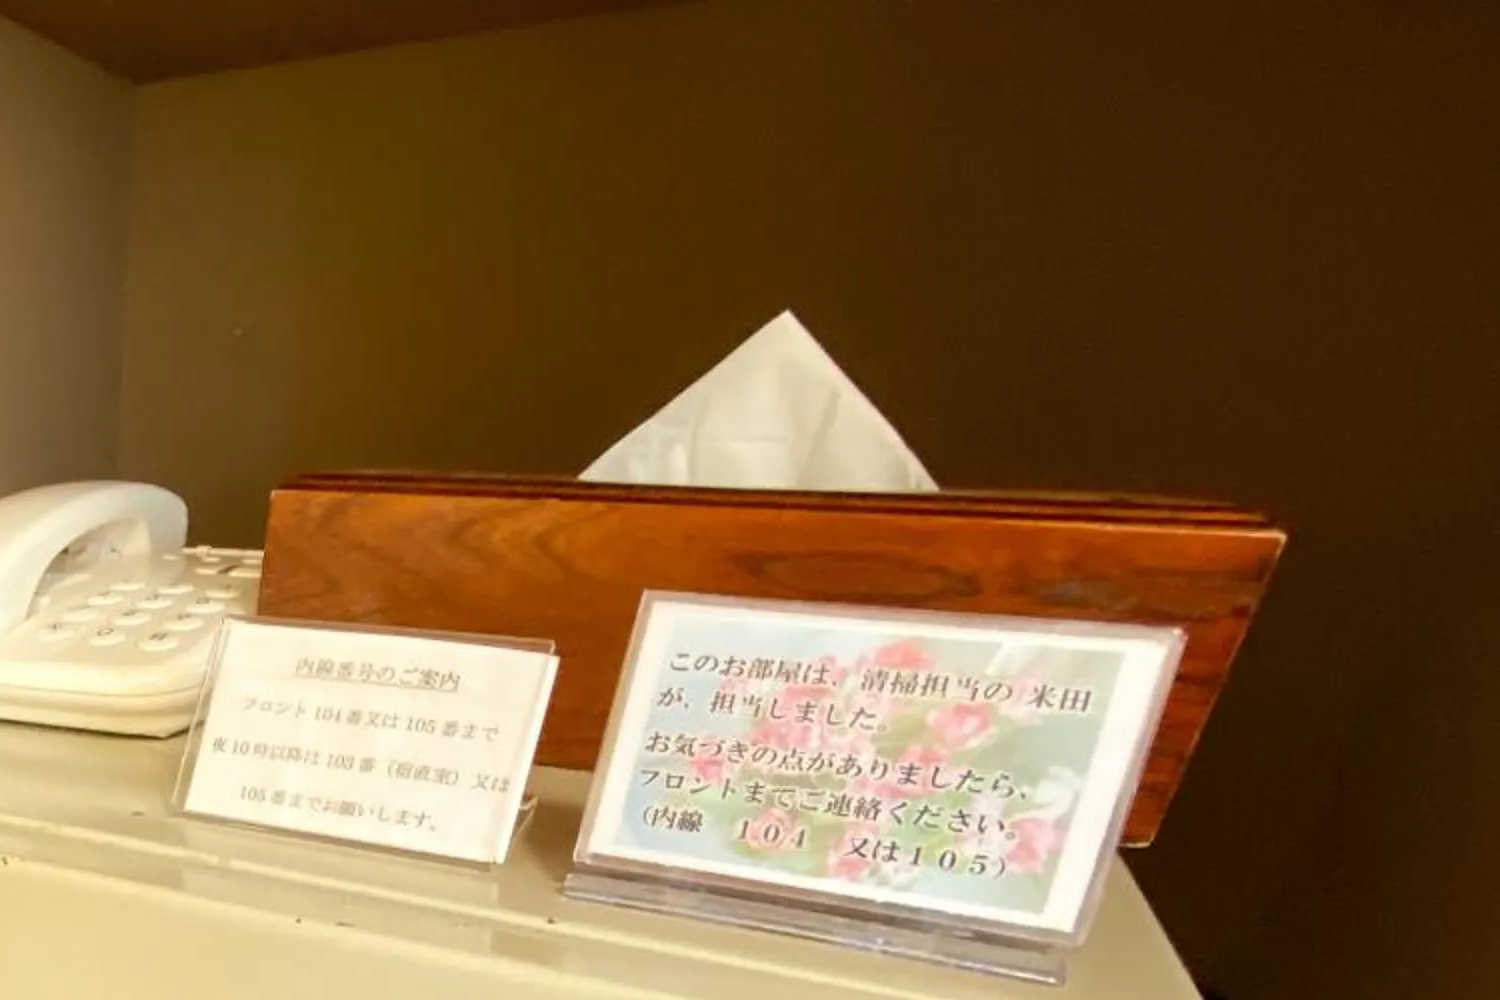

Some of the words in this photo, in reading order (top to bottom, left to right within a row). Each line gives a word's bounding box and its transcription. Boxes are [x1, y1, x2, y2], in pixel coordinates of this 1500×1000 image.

[639, 769, 1016, 840] フロントまでご連絡ください。
